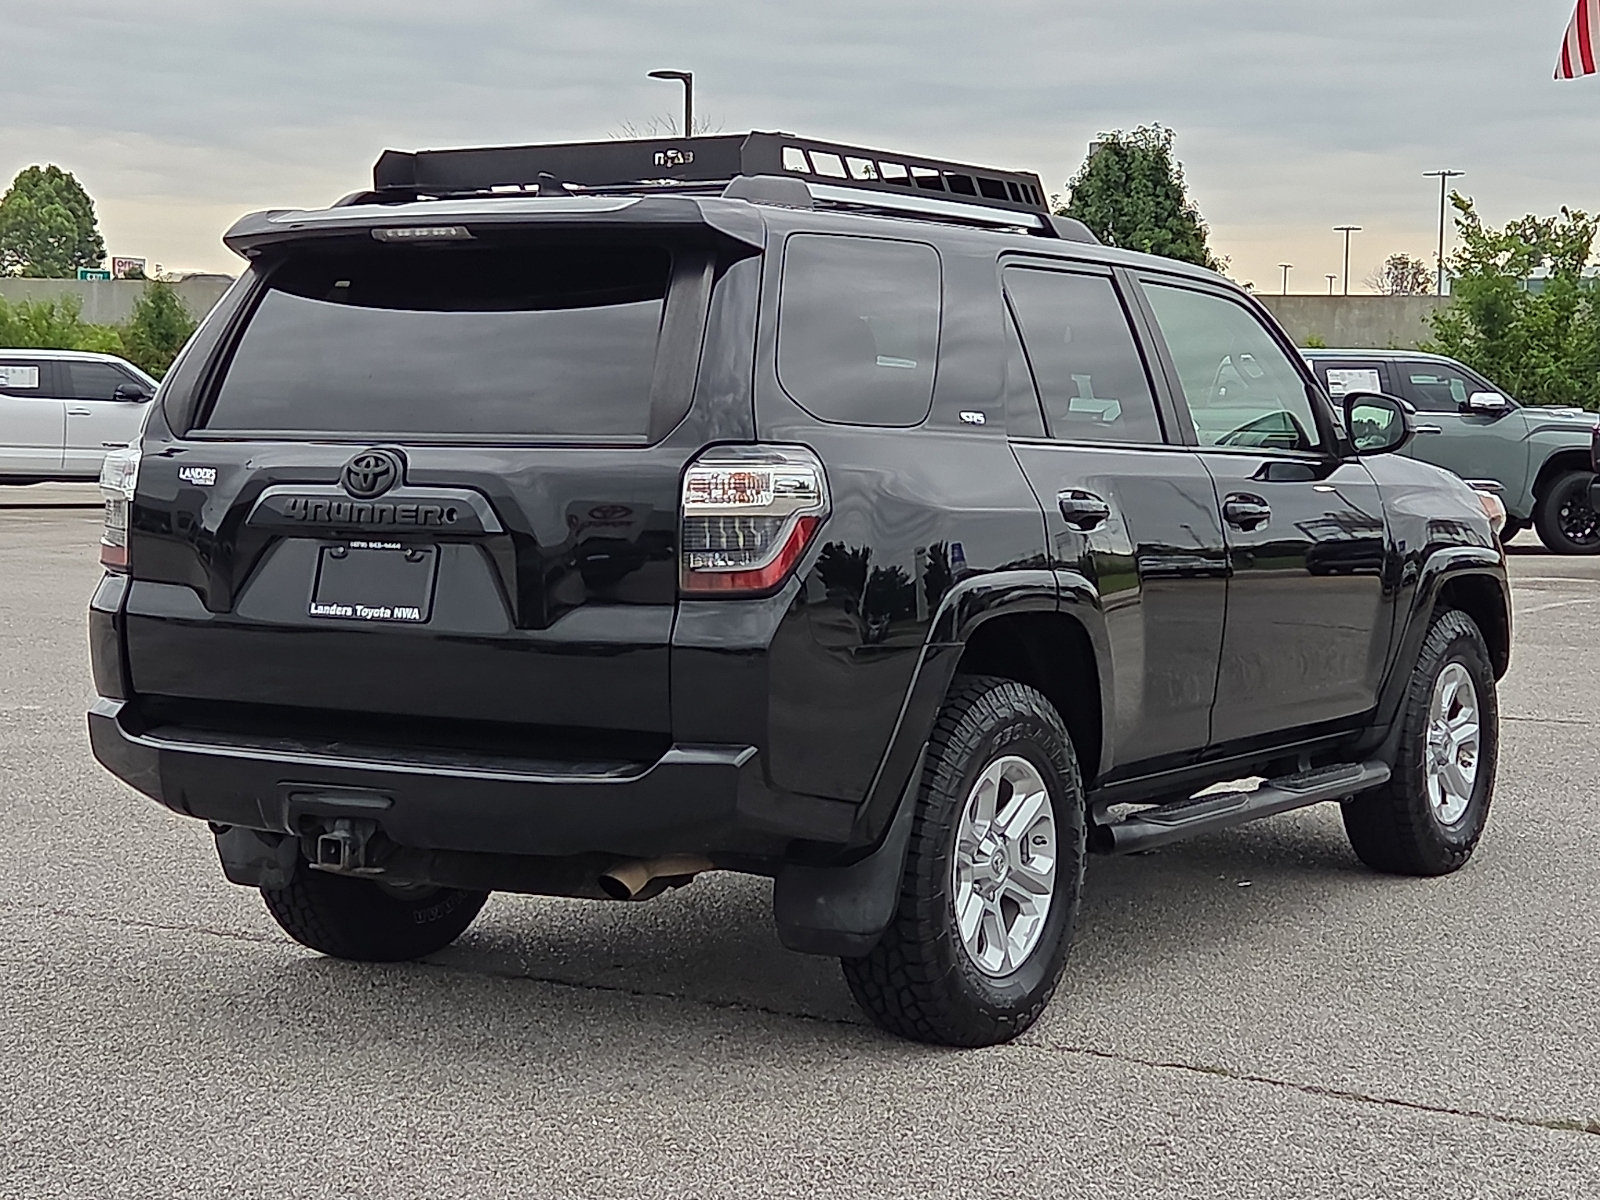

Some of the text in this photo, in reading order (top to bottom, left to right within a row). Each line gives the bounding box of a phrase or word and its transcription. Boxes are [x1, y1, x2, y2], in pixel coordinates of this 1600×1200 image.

[179, 467, 216, 480] LANDERS
[310, 603, 420, 619] Landers Toyota NWA
